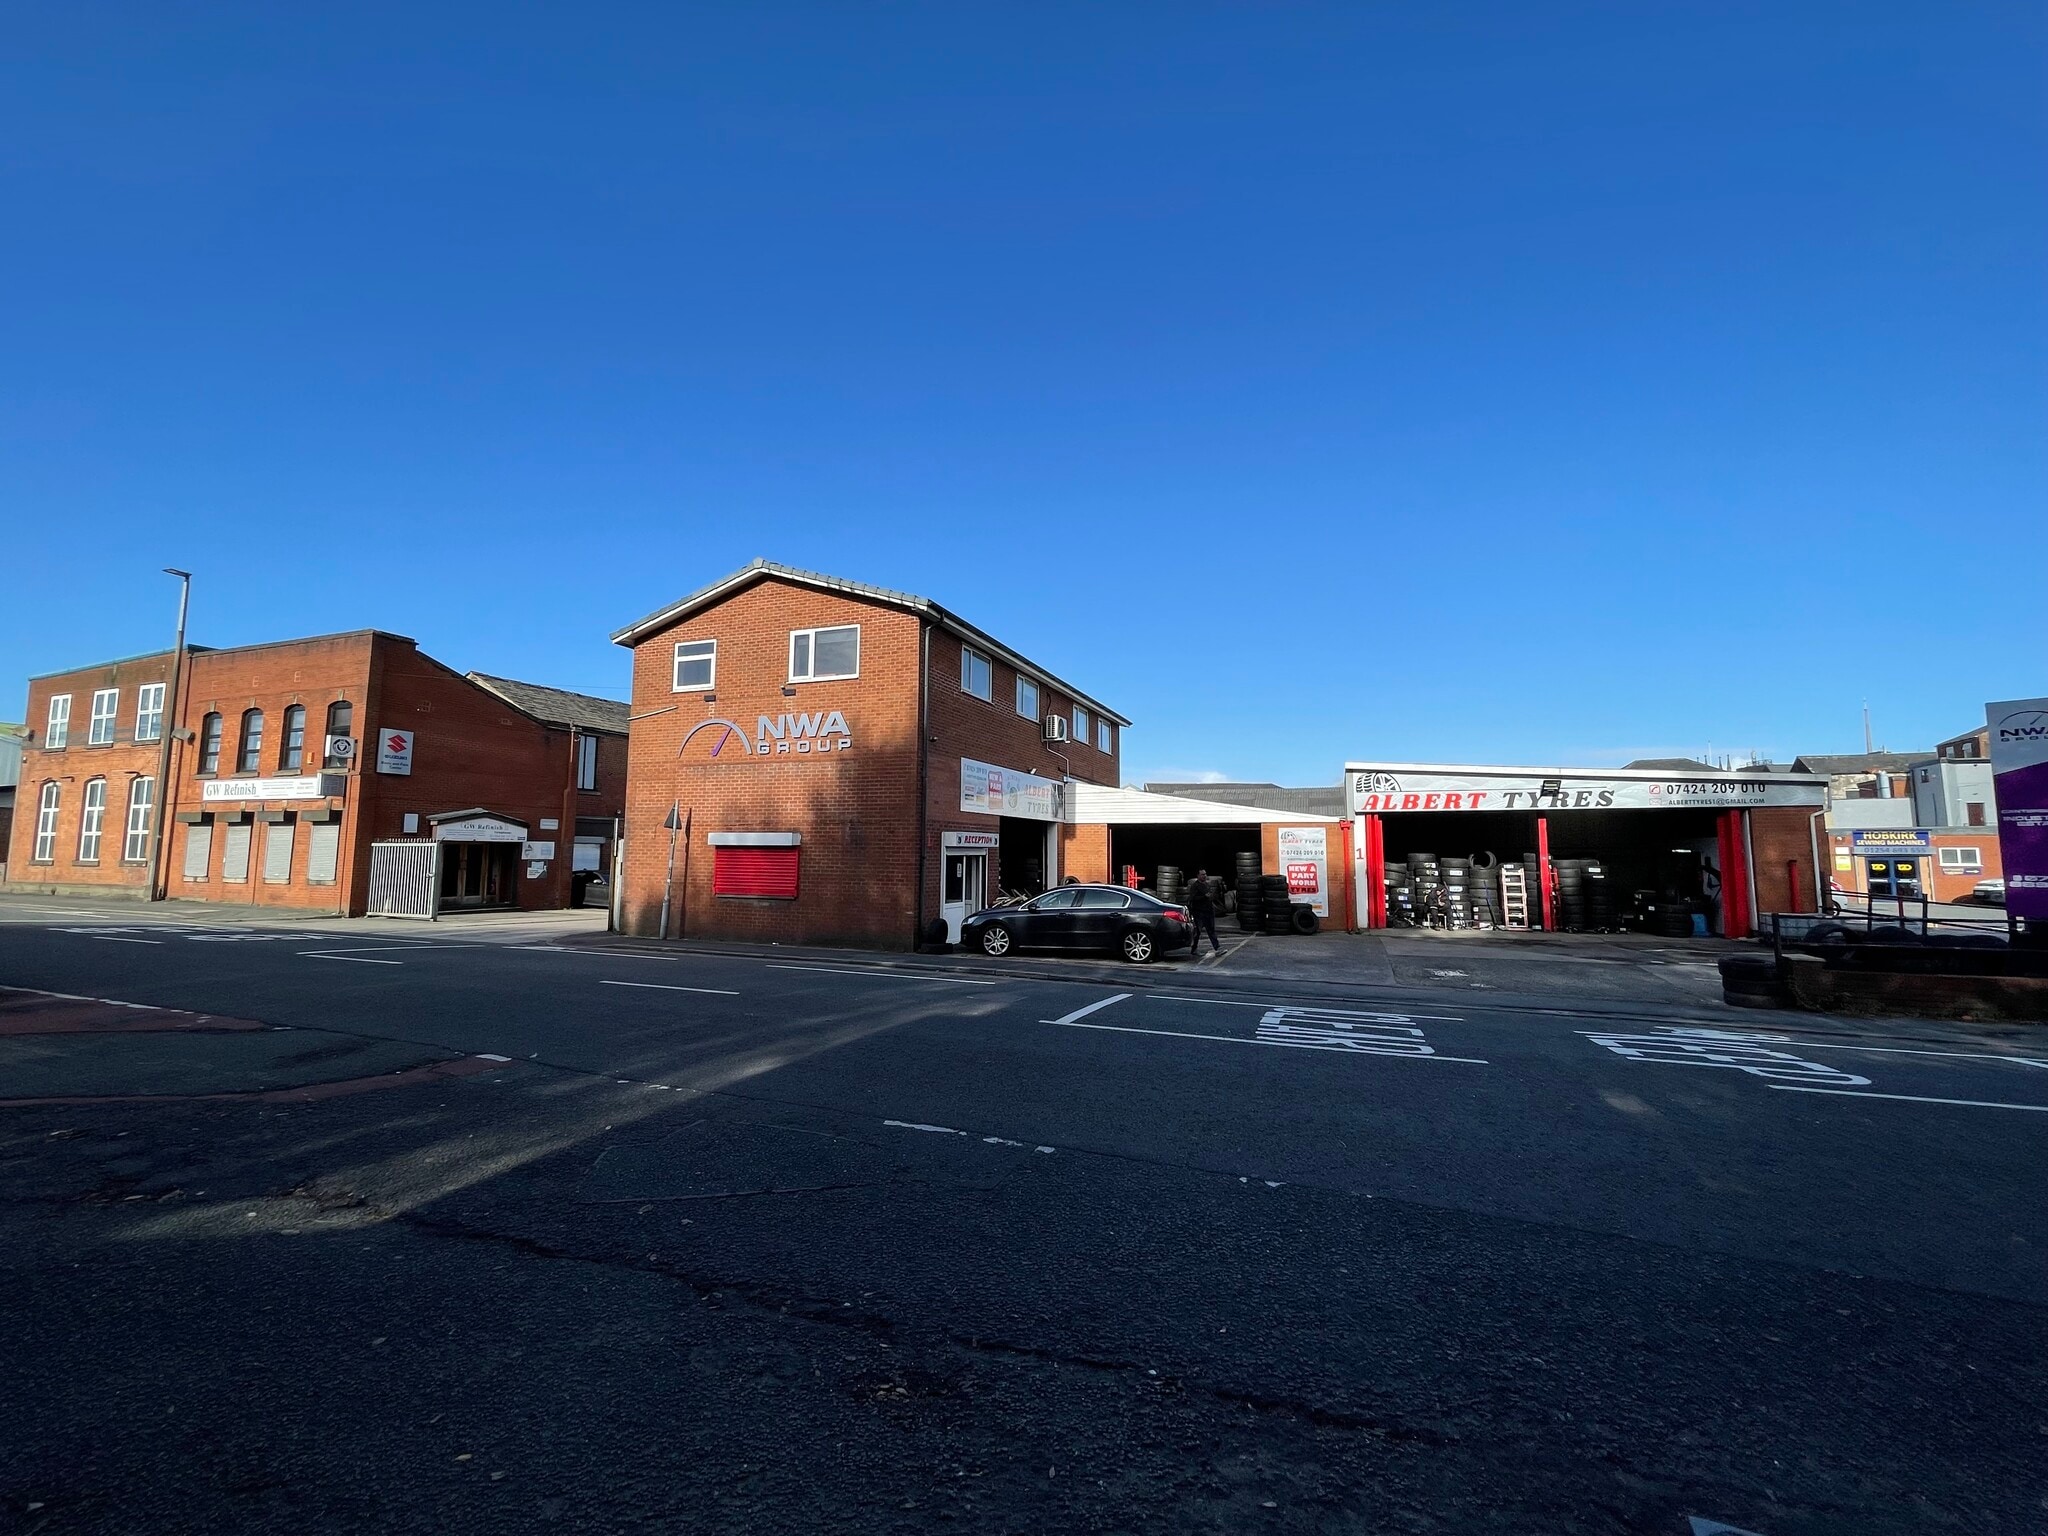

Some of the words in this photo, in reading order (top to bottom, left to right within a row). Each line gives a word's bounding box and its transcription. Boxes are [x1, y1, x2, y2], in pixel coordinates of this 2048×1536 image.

[757, 711, 852, 740] NWA
[2000, 727, 2048, 737] NW
[756, 738, 853, 755] GROUP
[206, 784, 221, 797] GW
[224, 782, 257, 796] Refinish
[1666, 784, 1707, 795] 07424
[1711, 783, 1736, 794] 209
[1740, 782, 1766, 793] 010
[1363, 793, 1487, 810] ALBERT
[1503, 790, 1615, 809] TYRES
[1027, 801, 1049, 815] TYRES
[964, 835, 993, 844] RECEPTION
[1356, 847, 1364, 860] 1
[1290, 886, 1317, 894] TYRES
